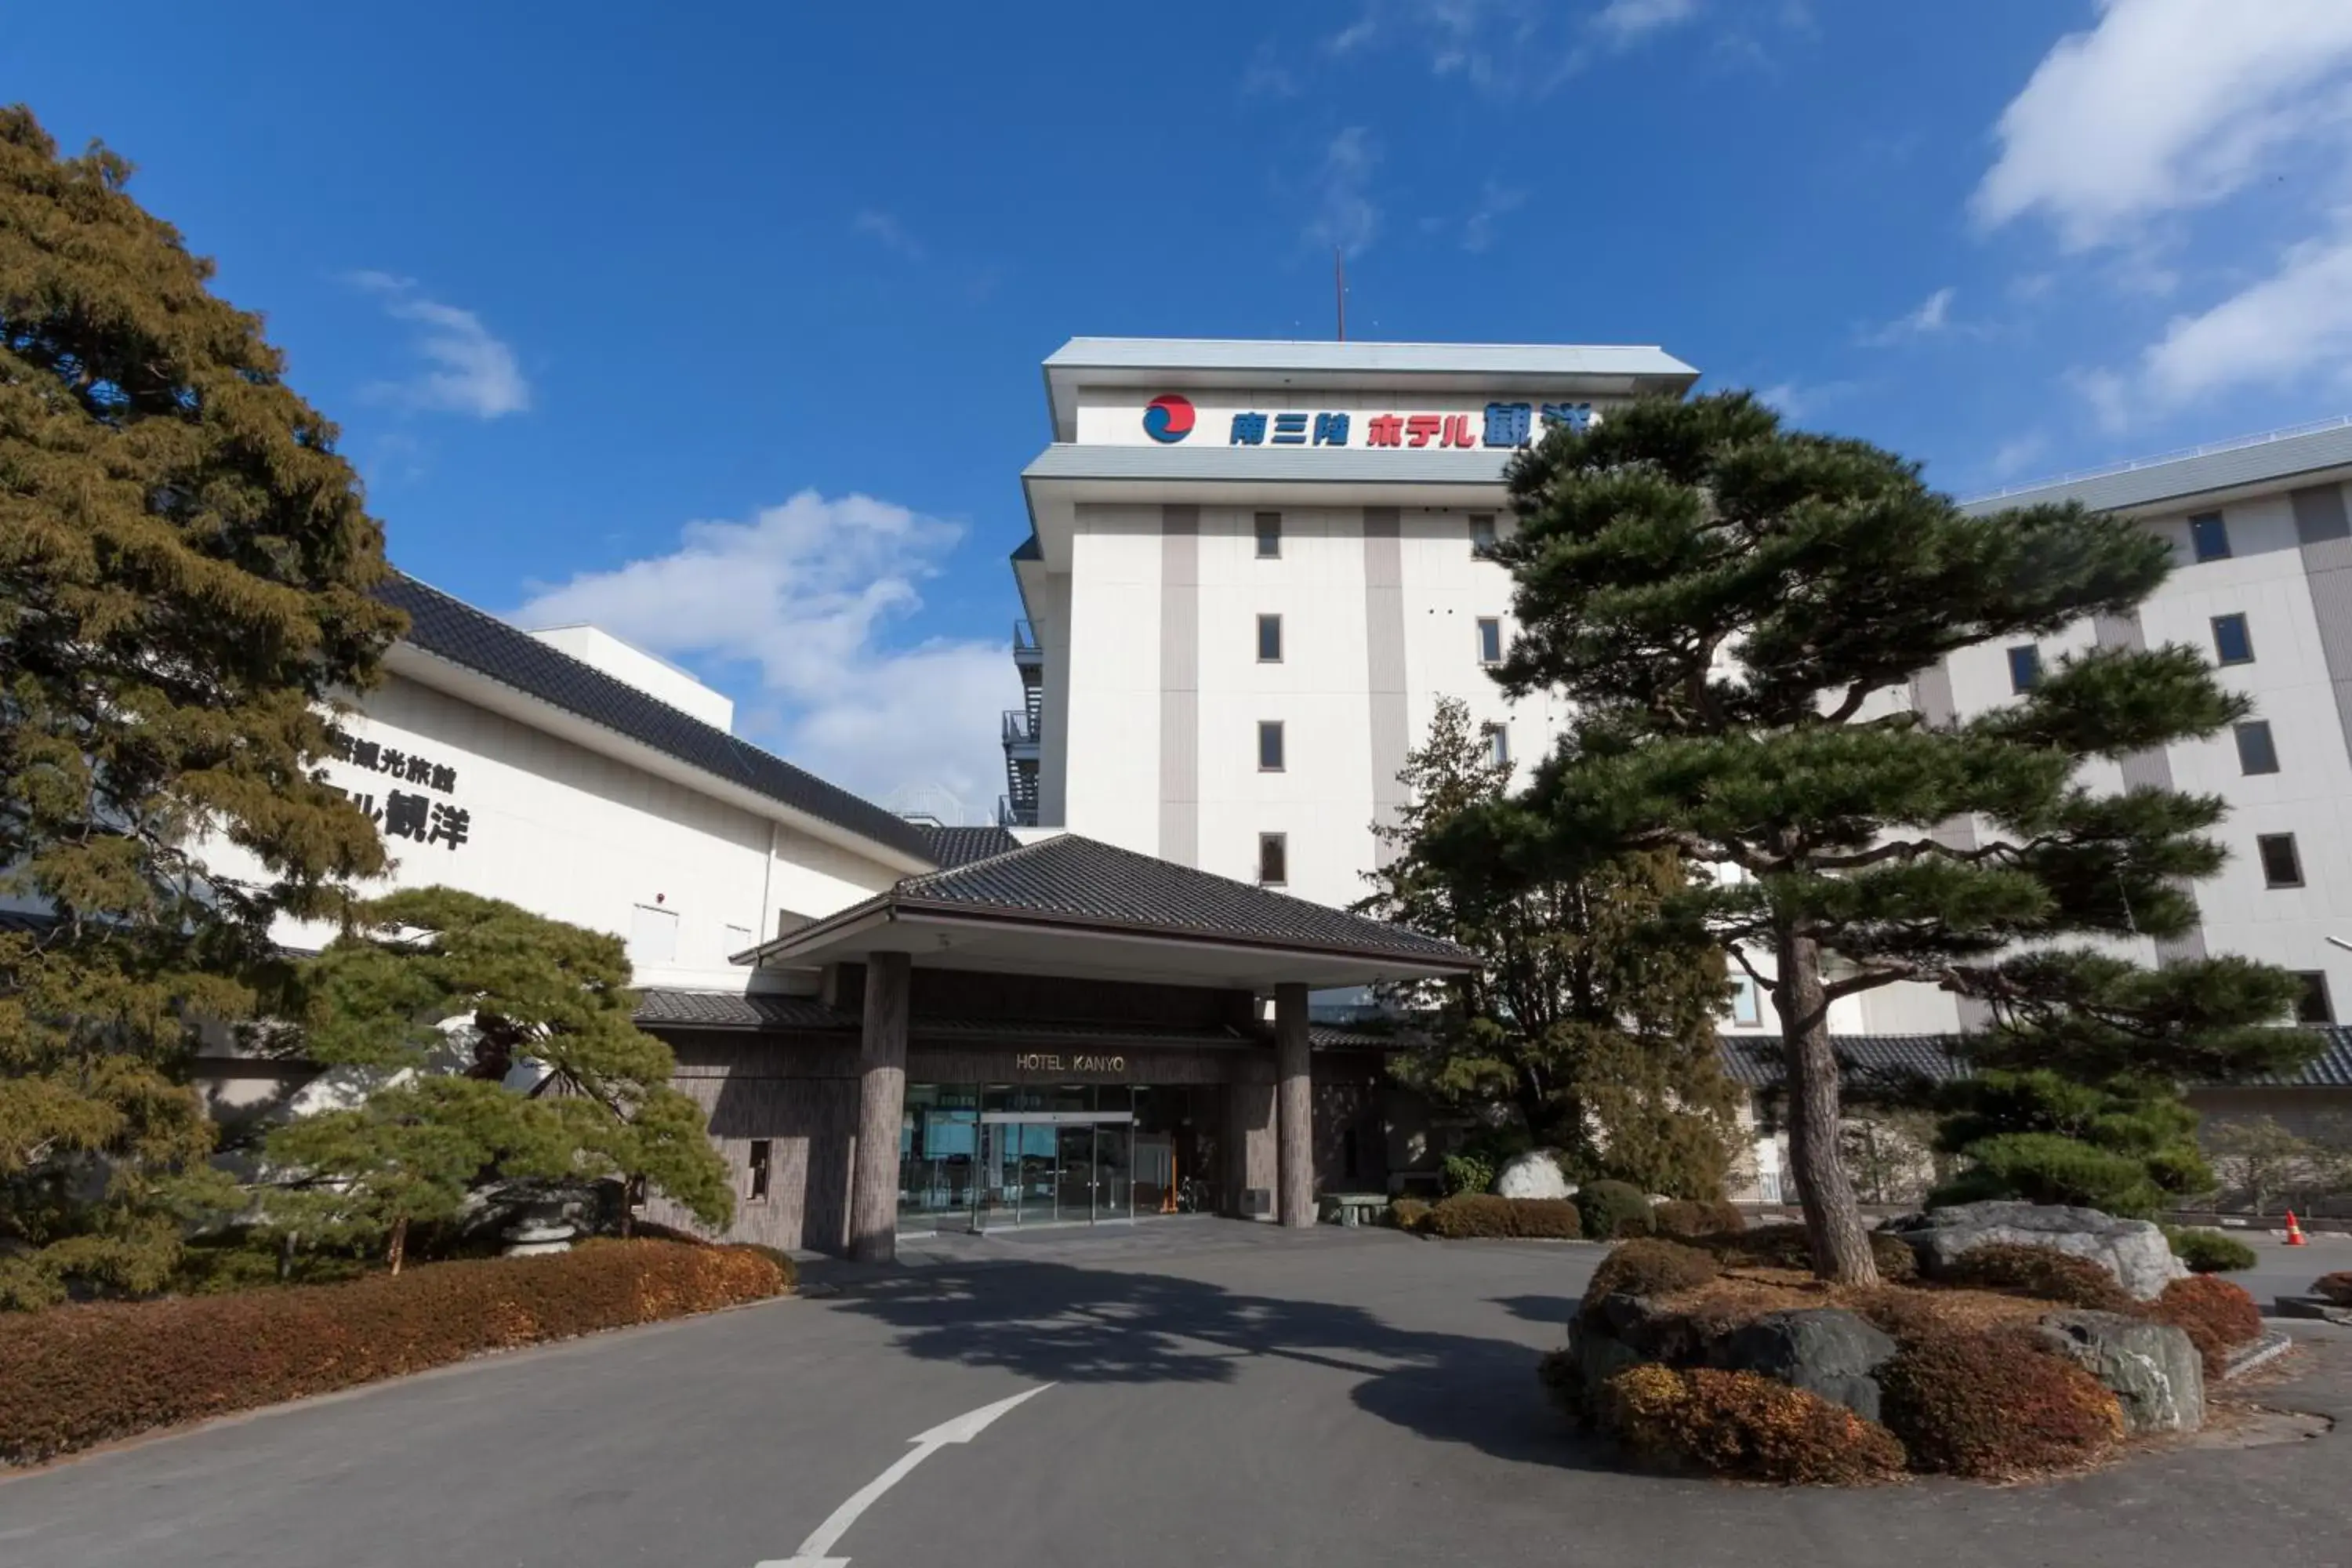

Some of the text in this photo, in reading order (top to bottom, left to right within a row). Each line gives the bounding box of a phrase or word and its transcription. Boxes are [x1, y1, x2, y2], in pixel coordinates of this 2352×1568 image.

[1230, 412, 1351, 445] 南三陸
[1016, 1054, 1124, 1072] HOTEL KANYO
